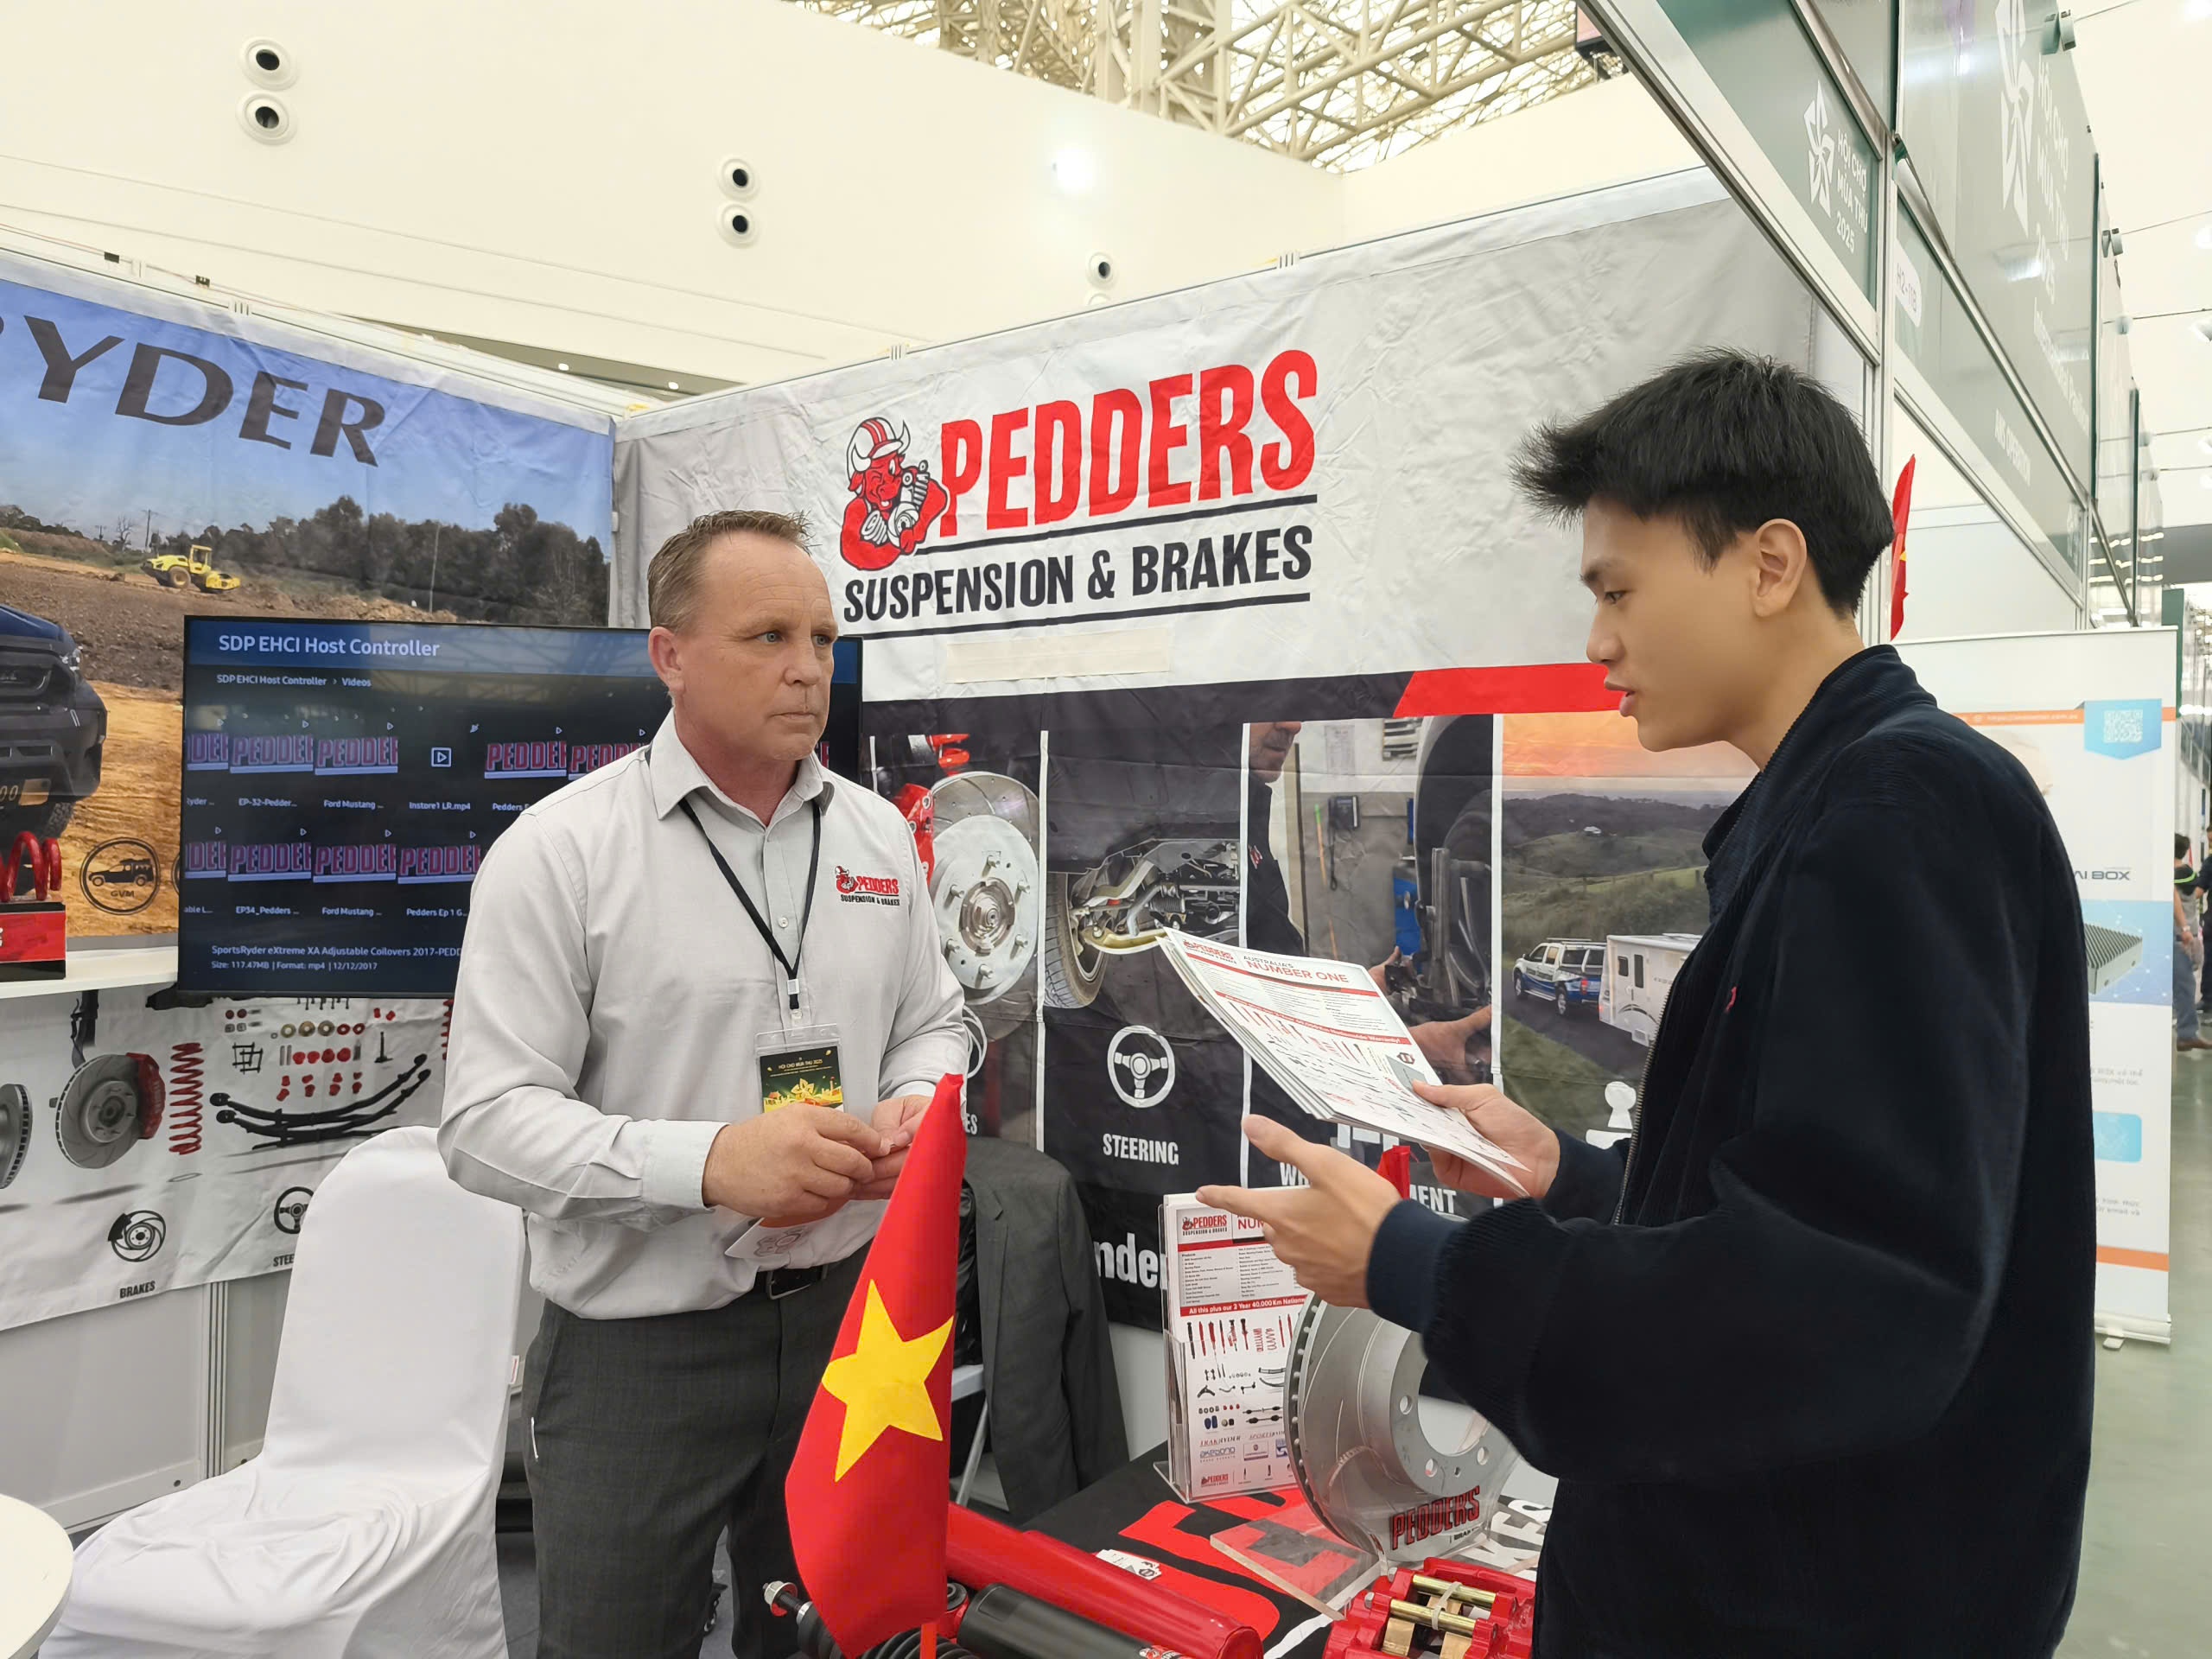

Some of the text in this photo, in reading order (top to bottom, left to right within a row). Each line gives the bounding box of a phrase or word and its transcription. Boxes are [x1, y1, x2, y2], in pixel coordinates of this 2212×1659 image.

[1854, 194, 1868, 233] THU
[1836, 211, 1855, 254] 2025
[0, 315, 385, 467] YDER
[940, 349, 1318, 537] PEDDERS
[844, 524, 1313, 623] SUSPENSION & BRAKES
[219, 635, 440, 657] SDP EHCI Host Controller
[217, 674, 372, 687] SDP EHCI Host Controller Videos
[323, 799, 341, 808] Ford
[342, 800, 376, 810] Mustang
[493, 803, 523, 811] Pedders
[856, 875, 899, 894] PEDDERS
[2092, 871, 2130, 880] BOX
[340, 907, 373, 917] Mustang
[212, 945, 266, 956] SportsRyder
[268, 946, 305, 955] eXtreme
[308, 946, 320, 955] XA
[321, 946, 368, 957] Adjustable
[371, 947, 410, 957] Coilovers
[308, 962, 325, 970] mp4
[1247, 961, 1350, 983] NUMBER ONE
[1103, 1133, 1179, 1166] STEERING
[1193, 1215, 1227, 1228] PEDDERS
[273, 1254, 294, 1267] STEE
[119, 1281, 156, 1298] BRAKES
[1392, 1485, 1480, 1550] PEDDERS
